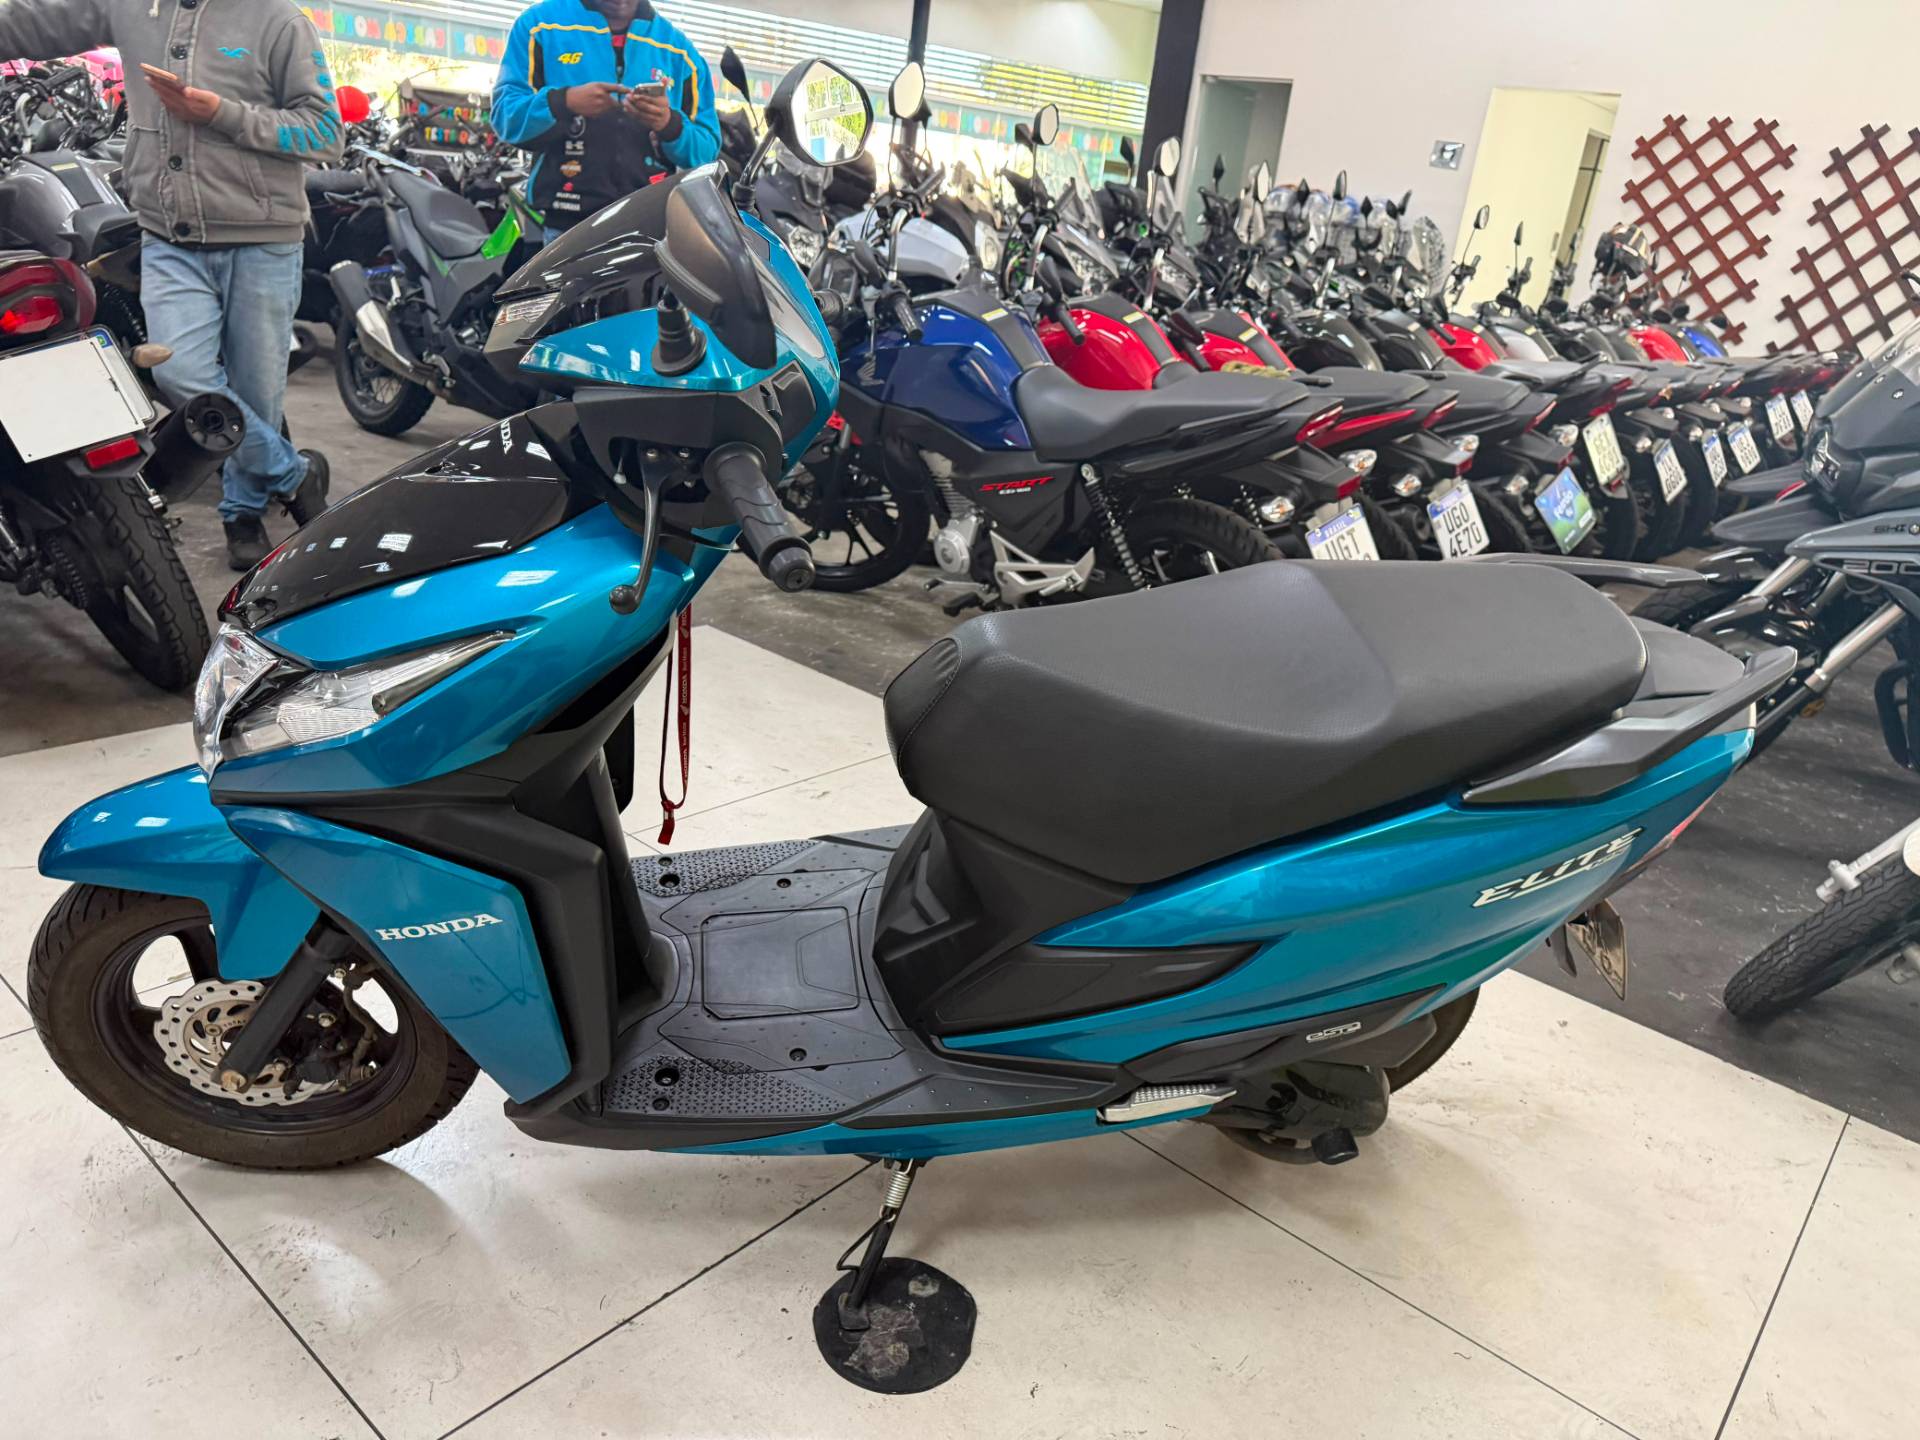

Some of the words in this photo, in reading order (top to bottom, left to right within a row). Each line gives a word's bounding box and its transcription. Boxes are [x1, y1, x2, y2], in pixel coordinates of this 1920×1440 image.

[557, 51, 583, 65] 46
[978, 476, 1055, 491] START
[375, 913, 503, 941] HONDA
